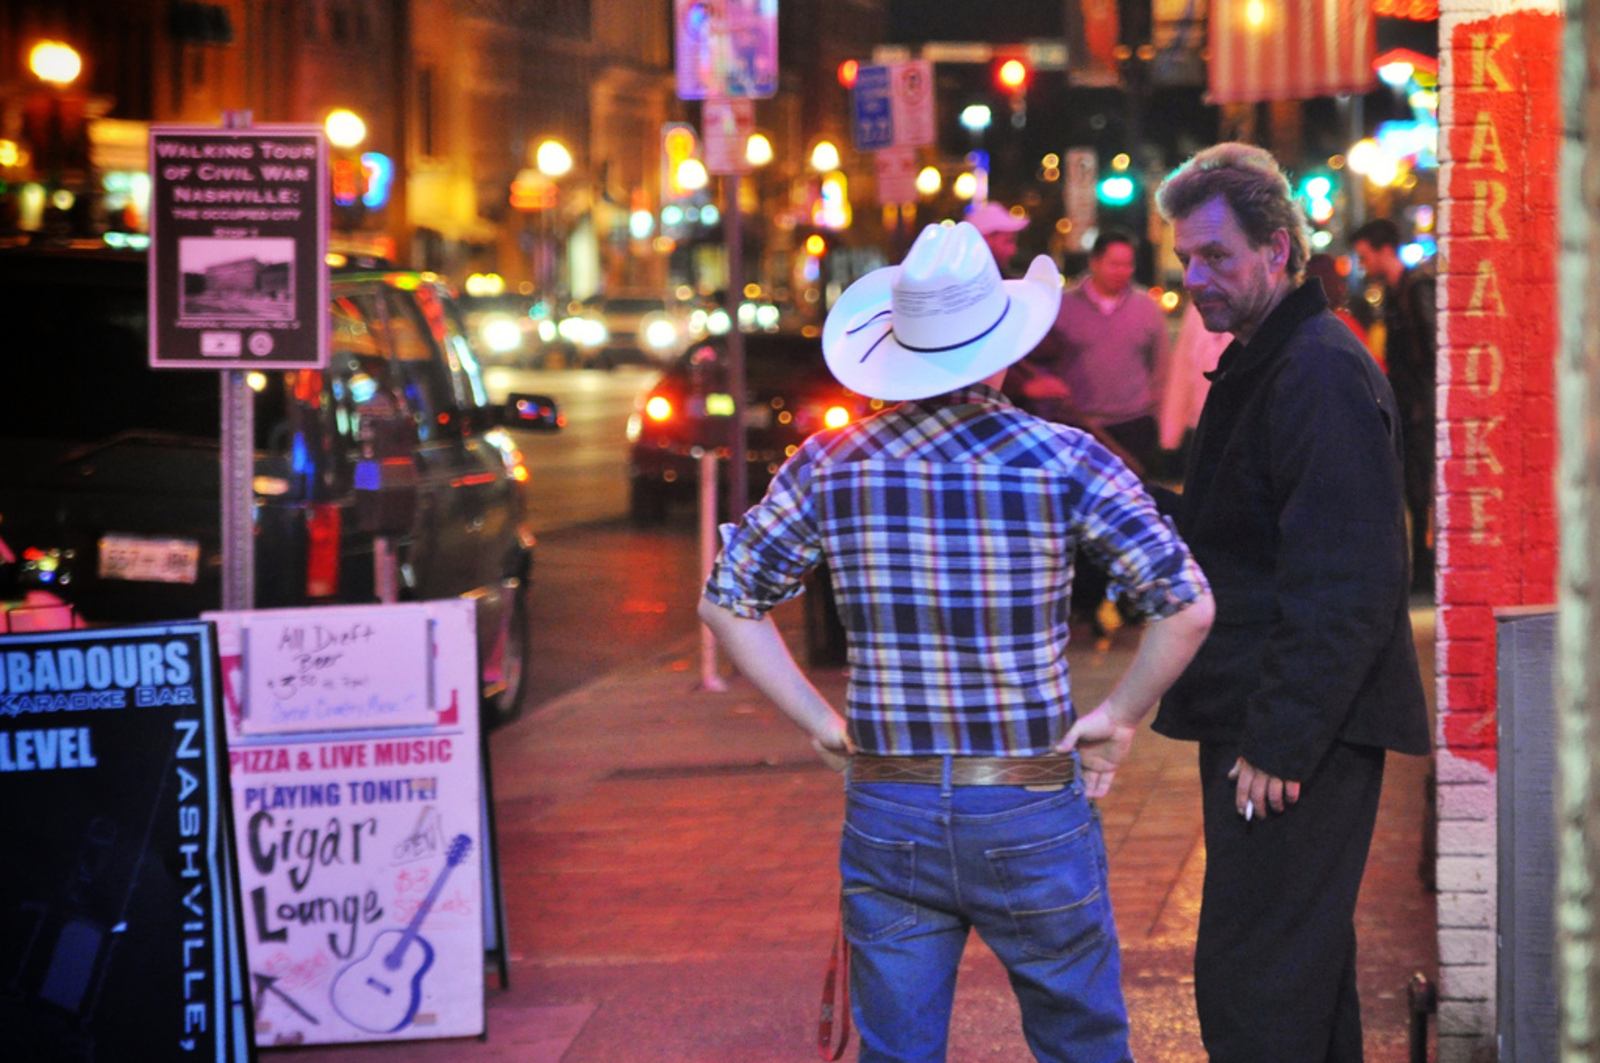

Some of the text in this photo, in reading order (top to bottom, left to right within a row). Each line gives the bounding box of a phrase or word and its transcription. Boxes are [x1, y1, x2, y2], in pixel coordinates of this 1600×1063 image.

[259, 141, 316, 159] TOUR
[197, 163, 255, 181] CIVIL
[259, 165, 309, 181] WAR
[1466, 32, 1514, 547] KARAOKE
[0, 641, 191, 691] BADOURS
[229, 739, 453, 774] PIZZA & LIVE MUSIC
[245, 783, 341, 811] PLAYING
[248, 810, 377, 893] Cigar
[251, 886, 384, 959] Lounge
